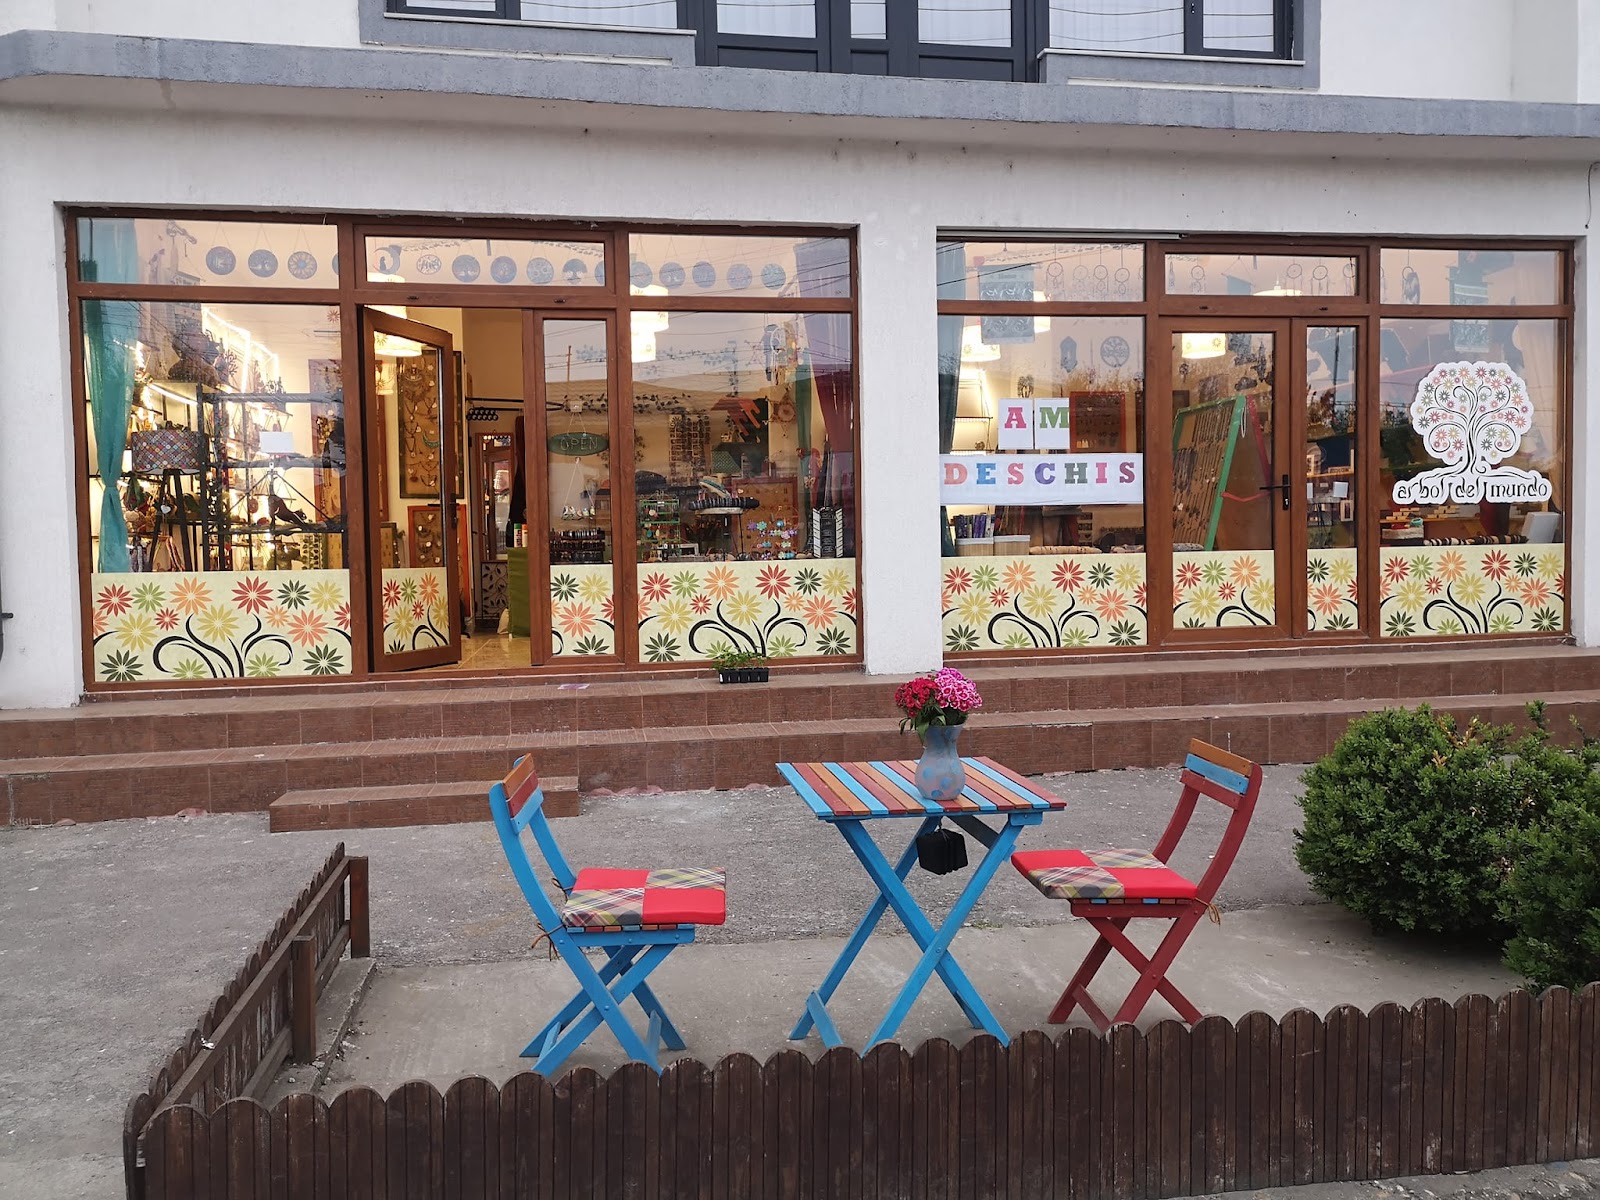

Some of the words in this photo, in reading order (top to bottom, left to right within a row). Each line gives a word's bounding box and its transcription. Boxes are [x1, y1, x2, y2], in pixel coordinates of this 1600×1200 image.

[1004, 406, 1070, 429] AM
[560, 436, 598, 451] OPEN
[943, 461, 1135, 485] DESCHIS
[1455, 476, 1481, 498] del
[1490, 475, 1548, 498] mundo
